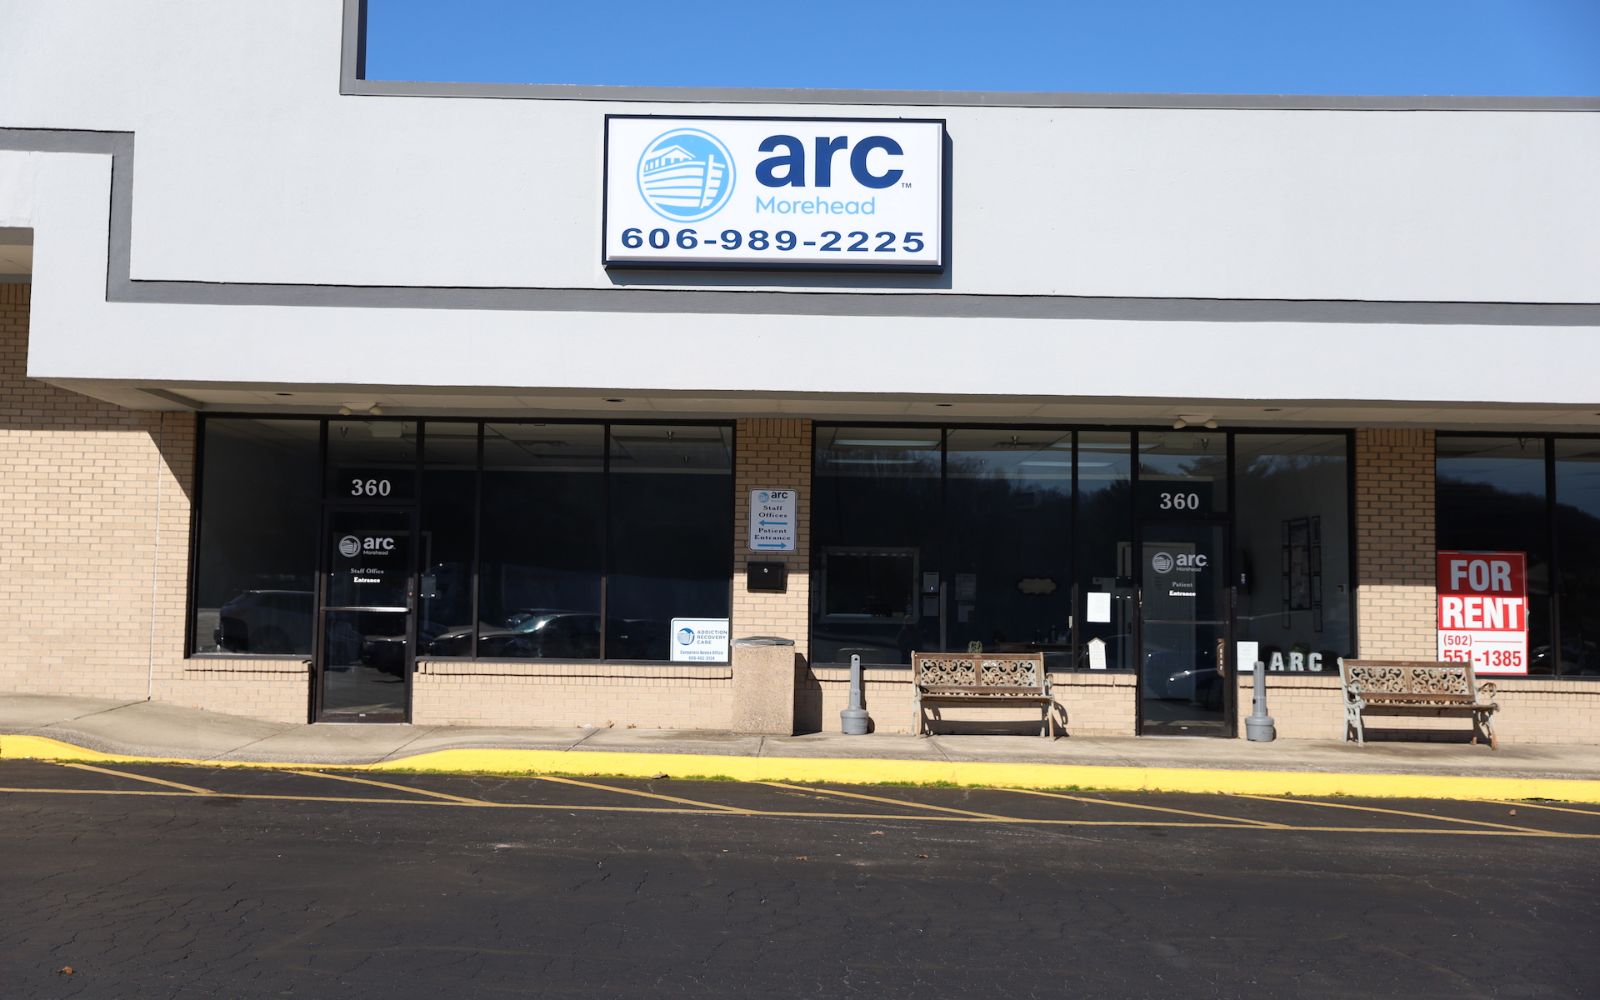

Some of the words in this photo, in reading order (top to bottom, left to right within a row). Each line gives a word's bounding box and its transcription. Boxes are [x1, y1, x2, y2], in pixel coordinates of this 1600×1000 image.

[755, 134, 905, 190] arc
[755, 194, 875, 216] Morehead
[621, 228, 925, 253] 606-989-2225
[351, 479, 391, 497] 360
[770, 491, 789, 500] arc
[1160, 493, 1200, 510] 360
[363, 537, 395, 550] arc
[1176, 553, 1208, 567] arc
[1450, 559, 1512, 592] FOR
[1442, 596, 1523, 629] RENT
[1443, 634, 1472, 647] (502)
[1269, 652, 1323, 671] ARC
[1443, 649, 1521, 667] 551-1385
